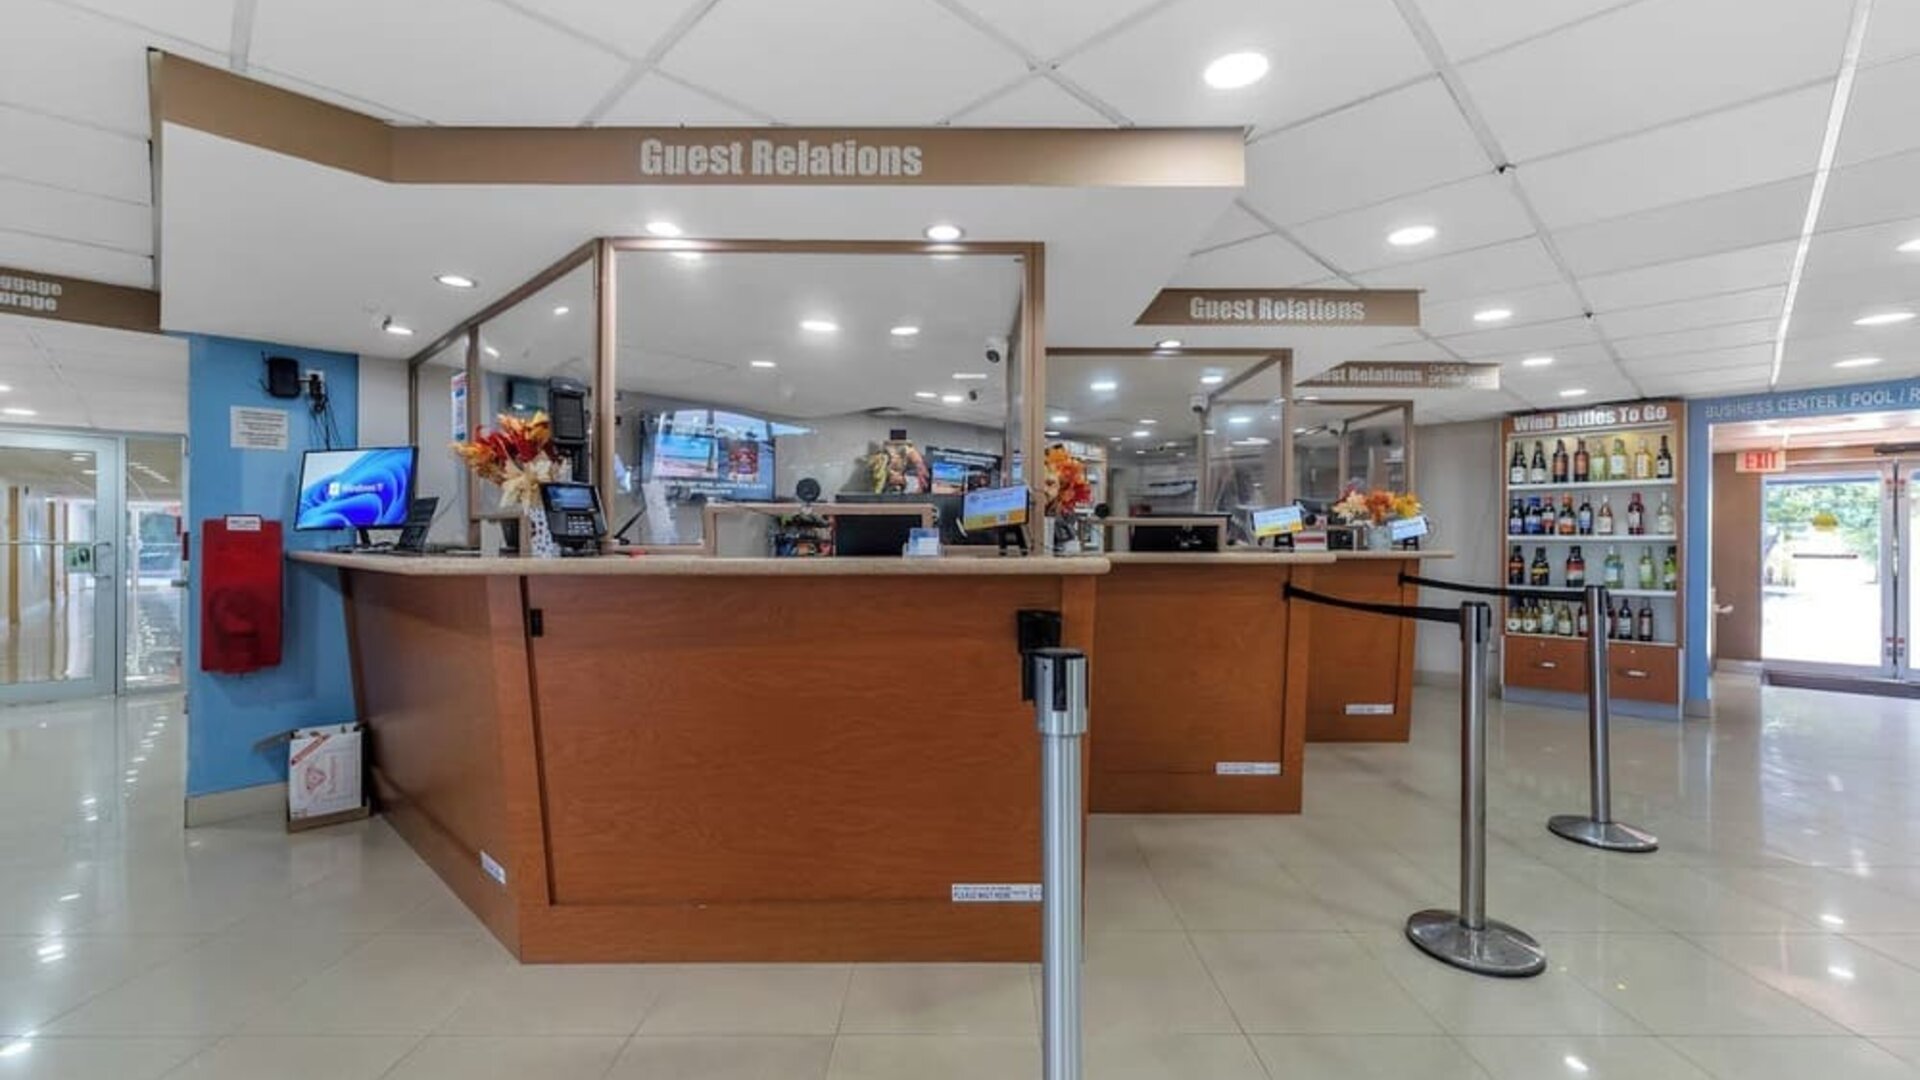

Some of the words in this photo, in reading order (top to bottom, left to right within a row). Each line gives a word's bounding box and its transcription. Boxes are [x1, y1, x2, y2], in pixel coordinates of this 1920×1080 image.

[641, 139, 743, 176] Guest
[751, 139, 922, 176] Relations
[0, 275, 62, 297] ggage
[0, 291, 57, 311] orage
[1190, 296, 1254, 320] Guest
[1258, 297, 1365, 321] Relations
[1350, 366, 1422, 382] Relations
[1705, 399, 1774, 418] BUSINESS
[1778, 394, 1837, 412] CENTER
[1851, 389, 1893, 407] POOL
[1910, 386, 1920, 402] R
[1514, 414, 1554, 431] Wine
[1557, 408, 1616, 428] Bottles
[1620, 406, 1639, 423] To
[1643, 404, 1668, 421] Go
[1744, 451, 1776, 469] EXIT
